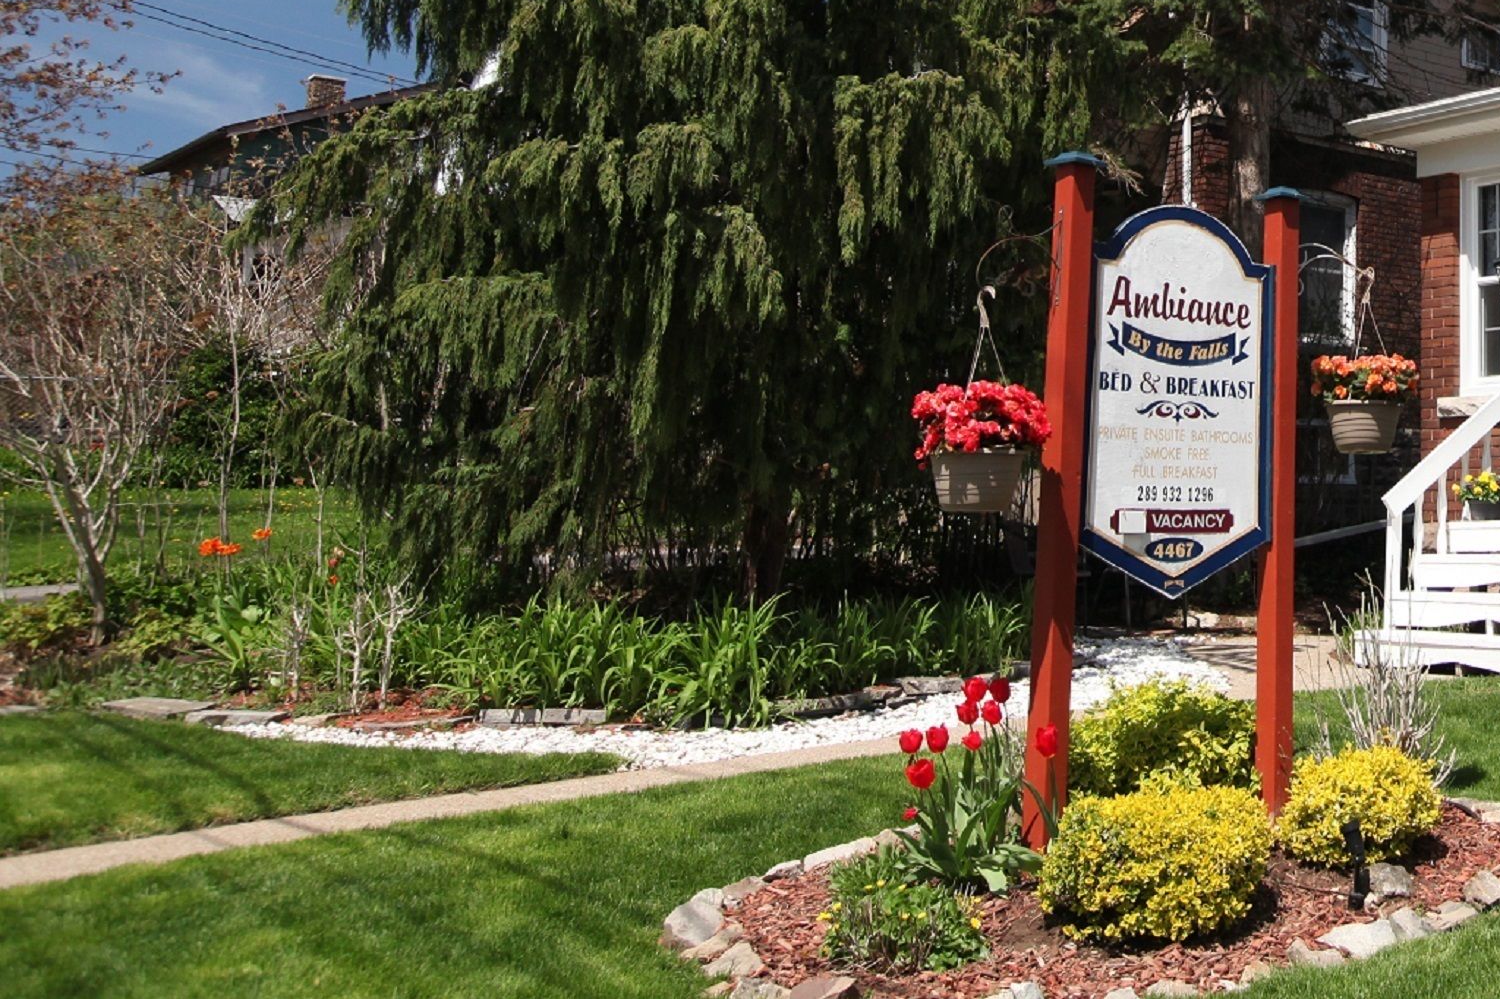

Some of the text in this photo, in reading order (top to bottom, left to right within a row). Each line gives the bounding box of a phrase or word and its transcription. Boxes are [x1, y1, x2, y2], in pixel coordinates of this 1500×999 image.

[1107, 275, 1251, 329] Ambiance
[1128, 331, 1229, 361] By the Falls
[1100, 371, 1255, 399] BED & BREAKFAST
[1099, 427, 1254, 444] PRIVATE ENSUITE BATHROOMS
[1144, 447, 1210, 461] SMOKE FREE
[1132, 465, 1218, 479] FULL BREAKFAST
[1137, 485, 1214, 502] 289 932 1296
[1152, 513, 1227, 528] VACANCY
[1153, 542, 1195, 559] 4467
